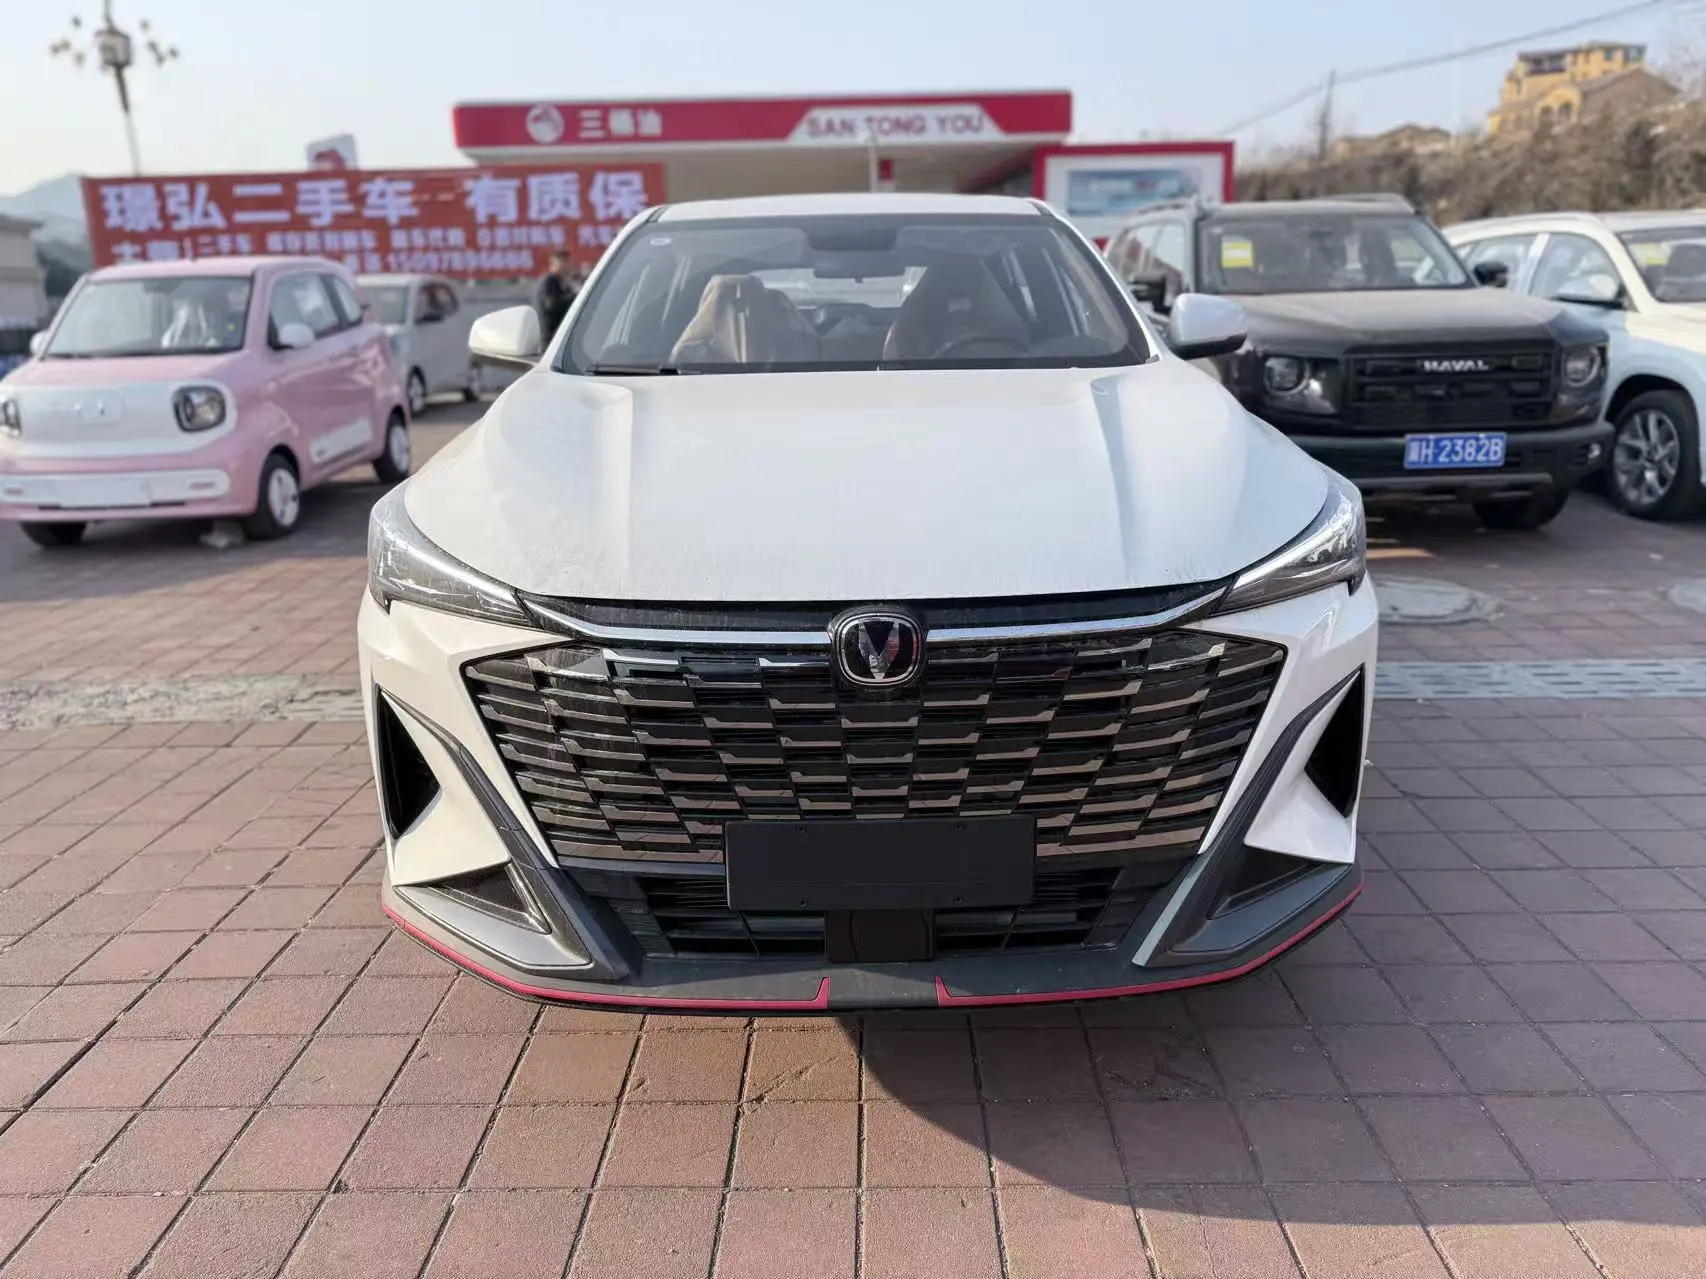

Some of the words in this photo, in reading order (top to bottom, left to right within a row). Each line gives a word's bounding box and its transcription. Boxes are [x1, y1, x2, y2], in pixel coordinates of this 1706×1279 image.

[807, 115, 855, 138] SAN
[866, 112, 926, 137] TONG
[934, 111, 984, 134] YOU
[464, 170, 648, 223] 有质保
[1423, 359, 1490, 372] HAVAL
